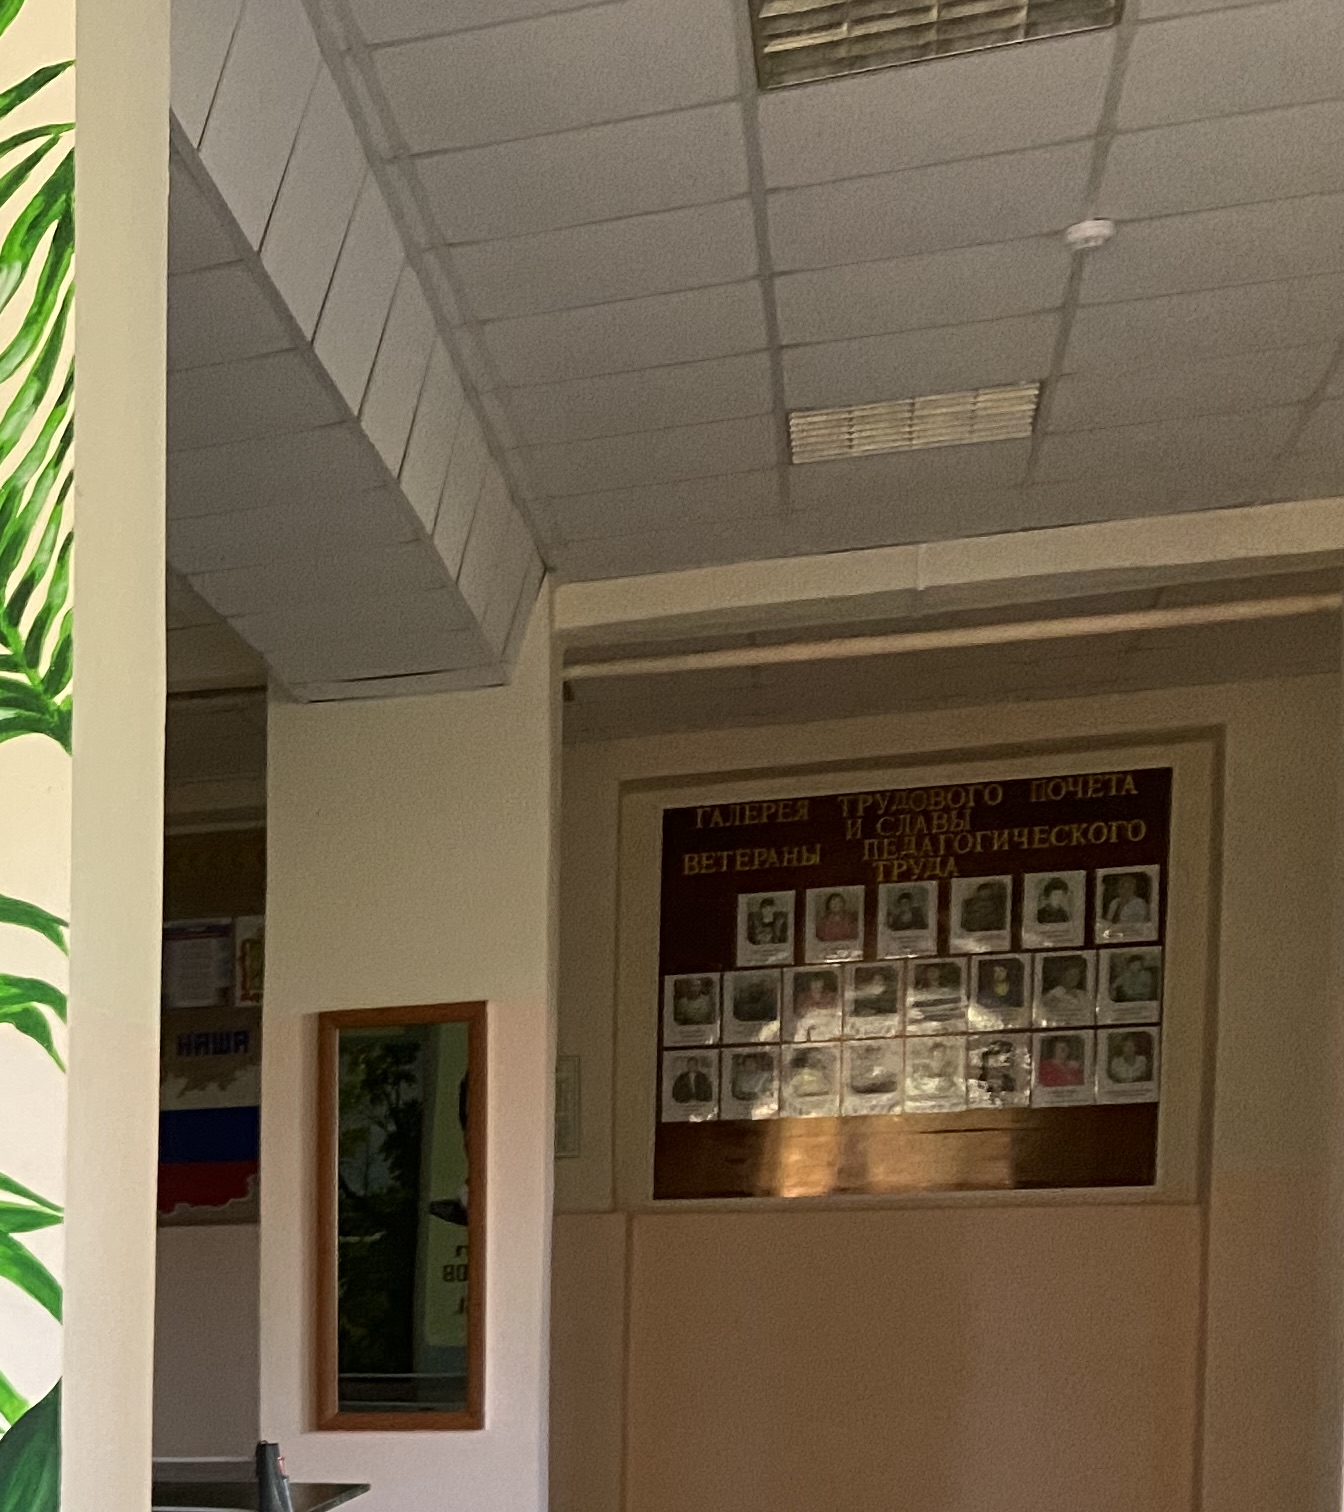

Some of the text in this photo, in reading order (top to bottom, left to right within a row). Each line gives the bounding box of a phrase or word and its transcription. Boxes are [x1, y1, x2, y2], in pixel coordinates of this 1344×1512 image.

[696, 774, 1139, 829] ГАЛЕРЕЯ ТРУДОВОГО ПОЧЕТА
[845, 809, 973, 841] И СЛАВЫ
[683, 819, 1147, 875] ВЕТЕРАНЫ ПЕДАГОГИЧЕСКОГО
[872, 856, 960, 883] ТРУДА
